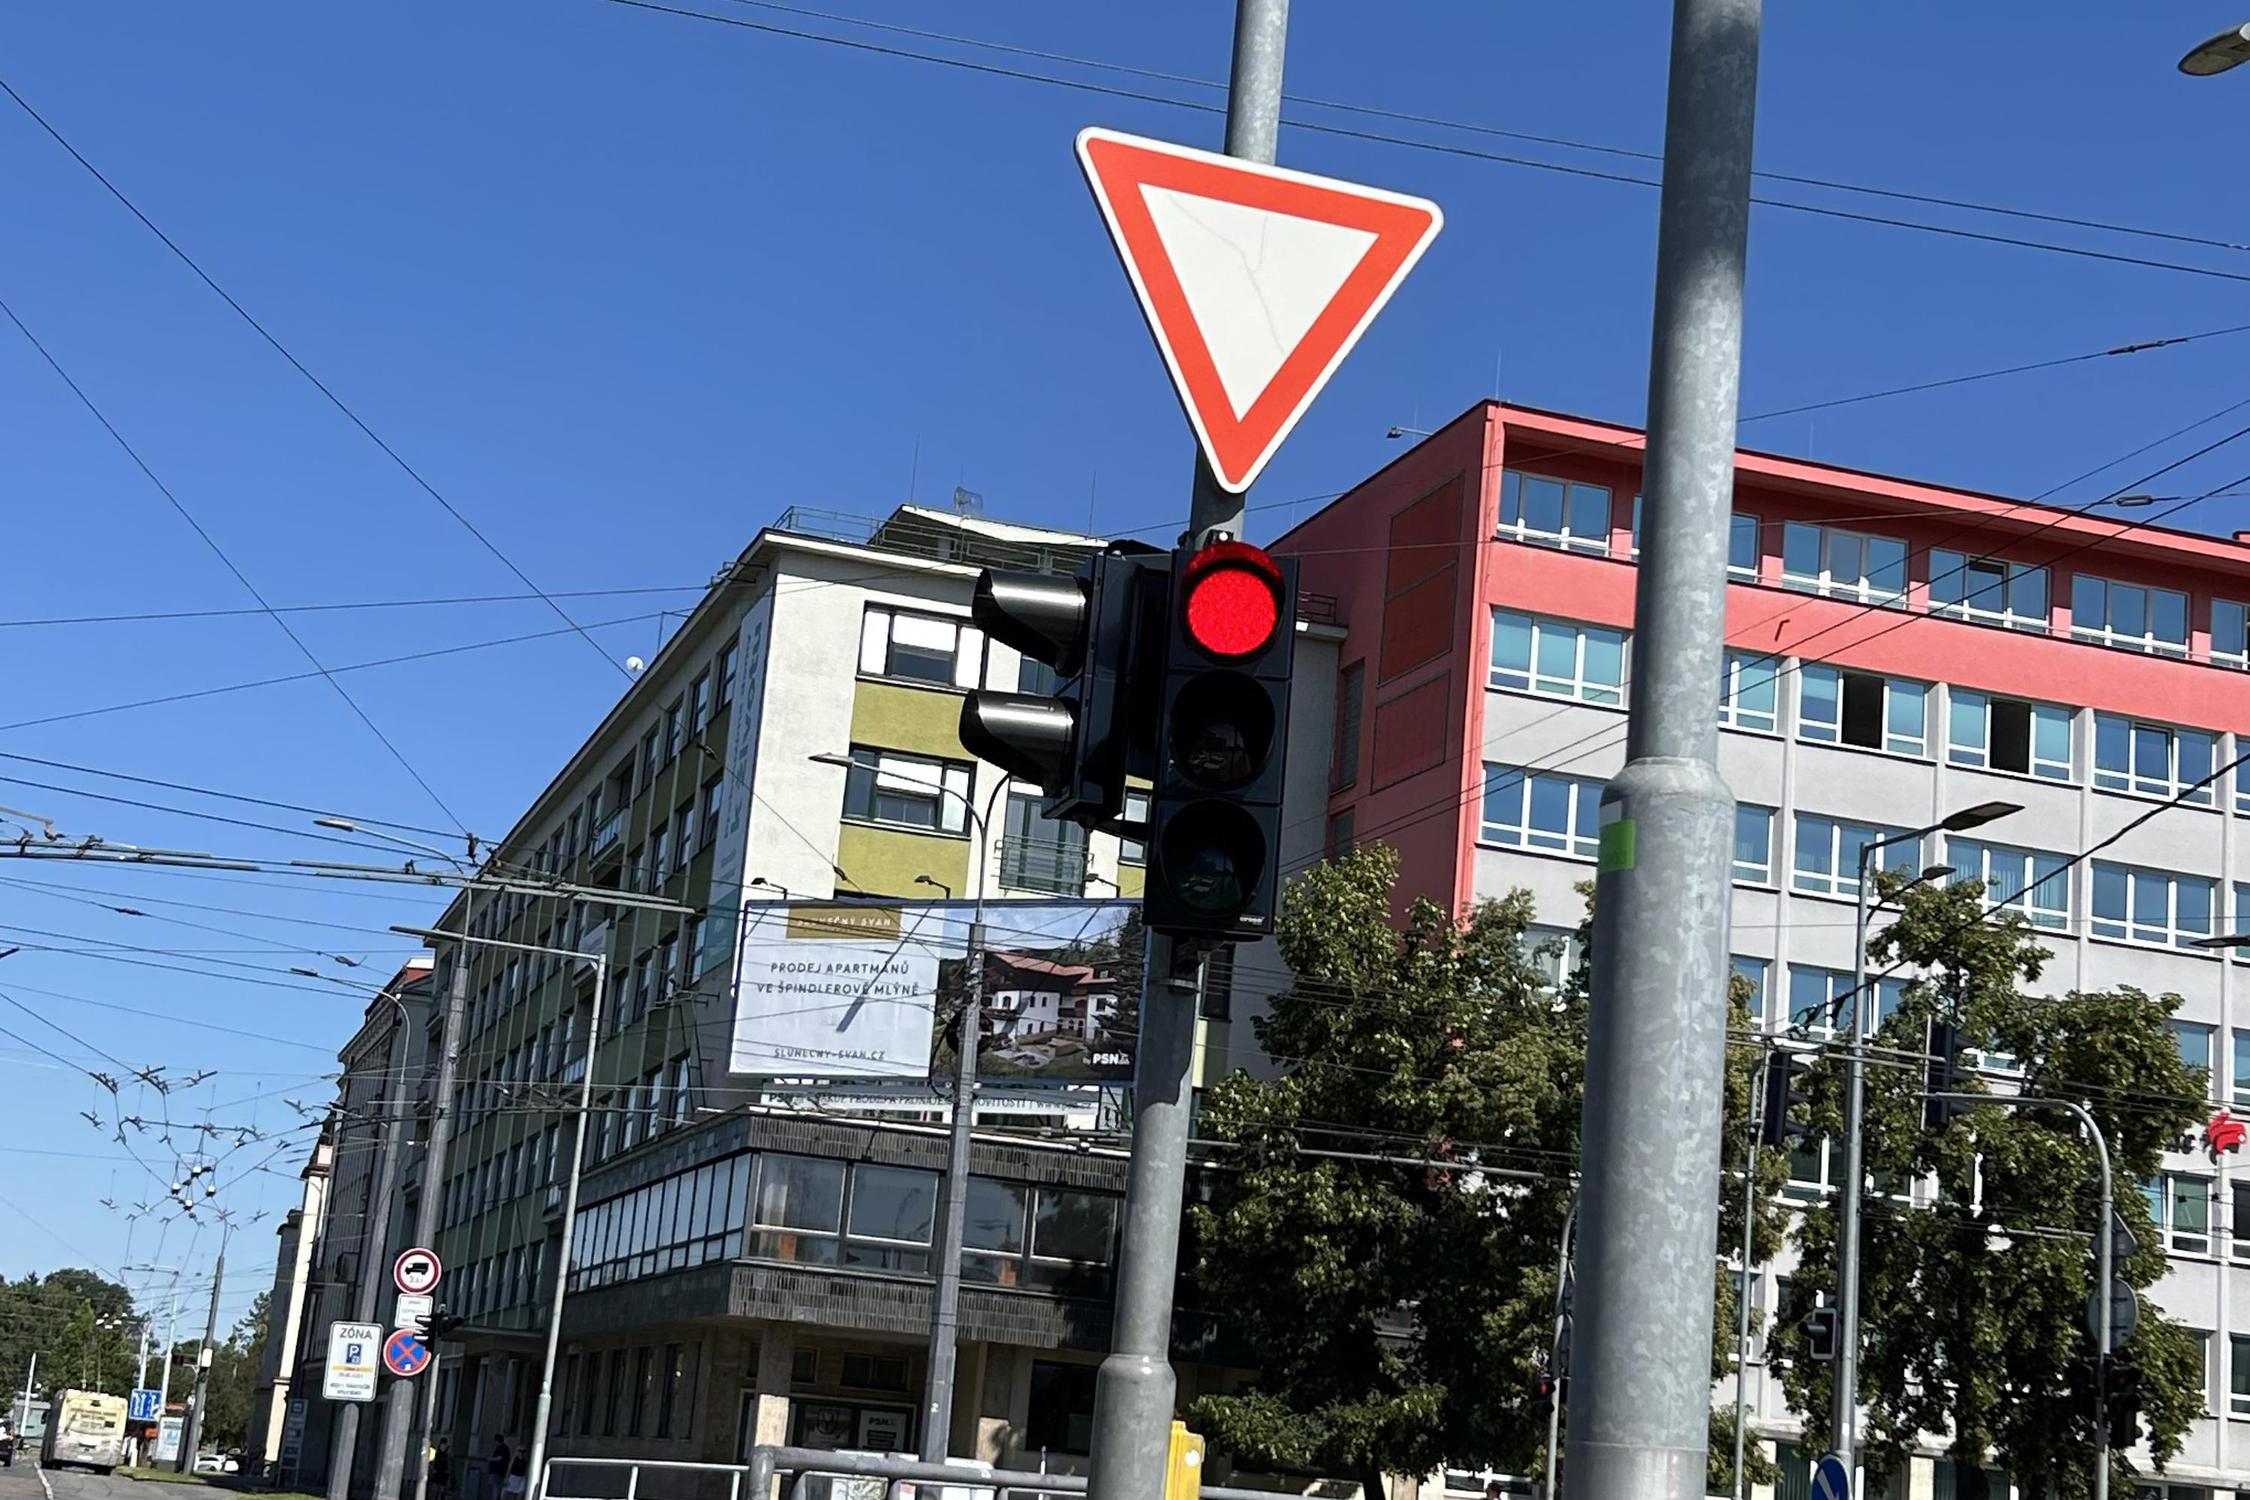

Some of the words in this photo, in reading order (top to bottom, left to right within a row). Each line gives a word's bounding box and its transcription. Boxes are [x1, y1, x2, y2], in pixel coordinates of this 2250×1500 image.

[771, 963, 820, 974] PRODEJ
[757, 983, 773, 993] VE
[1092, 1053, 1120, 1064] PSN
[340, 1327, 372, 1340] ZÓNA
